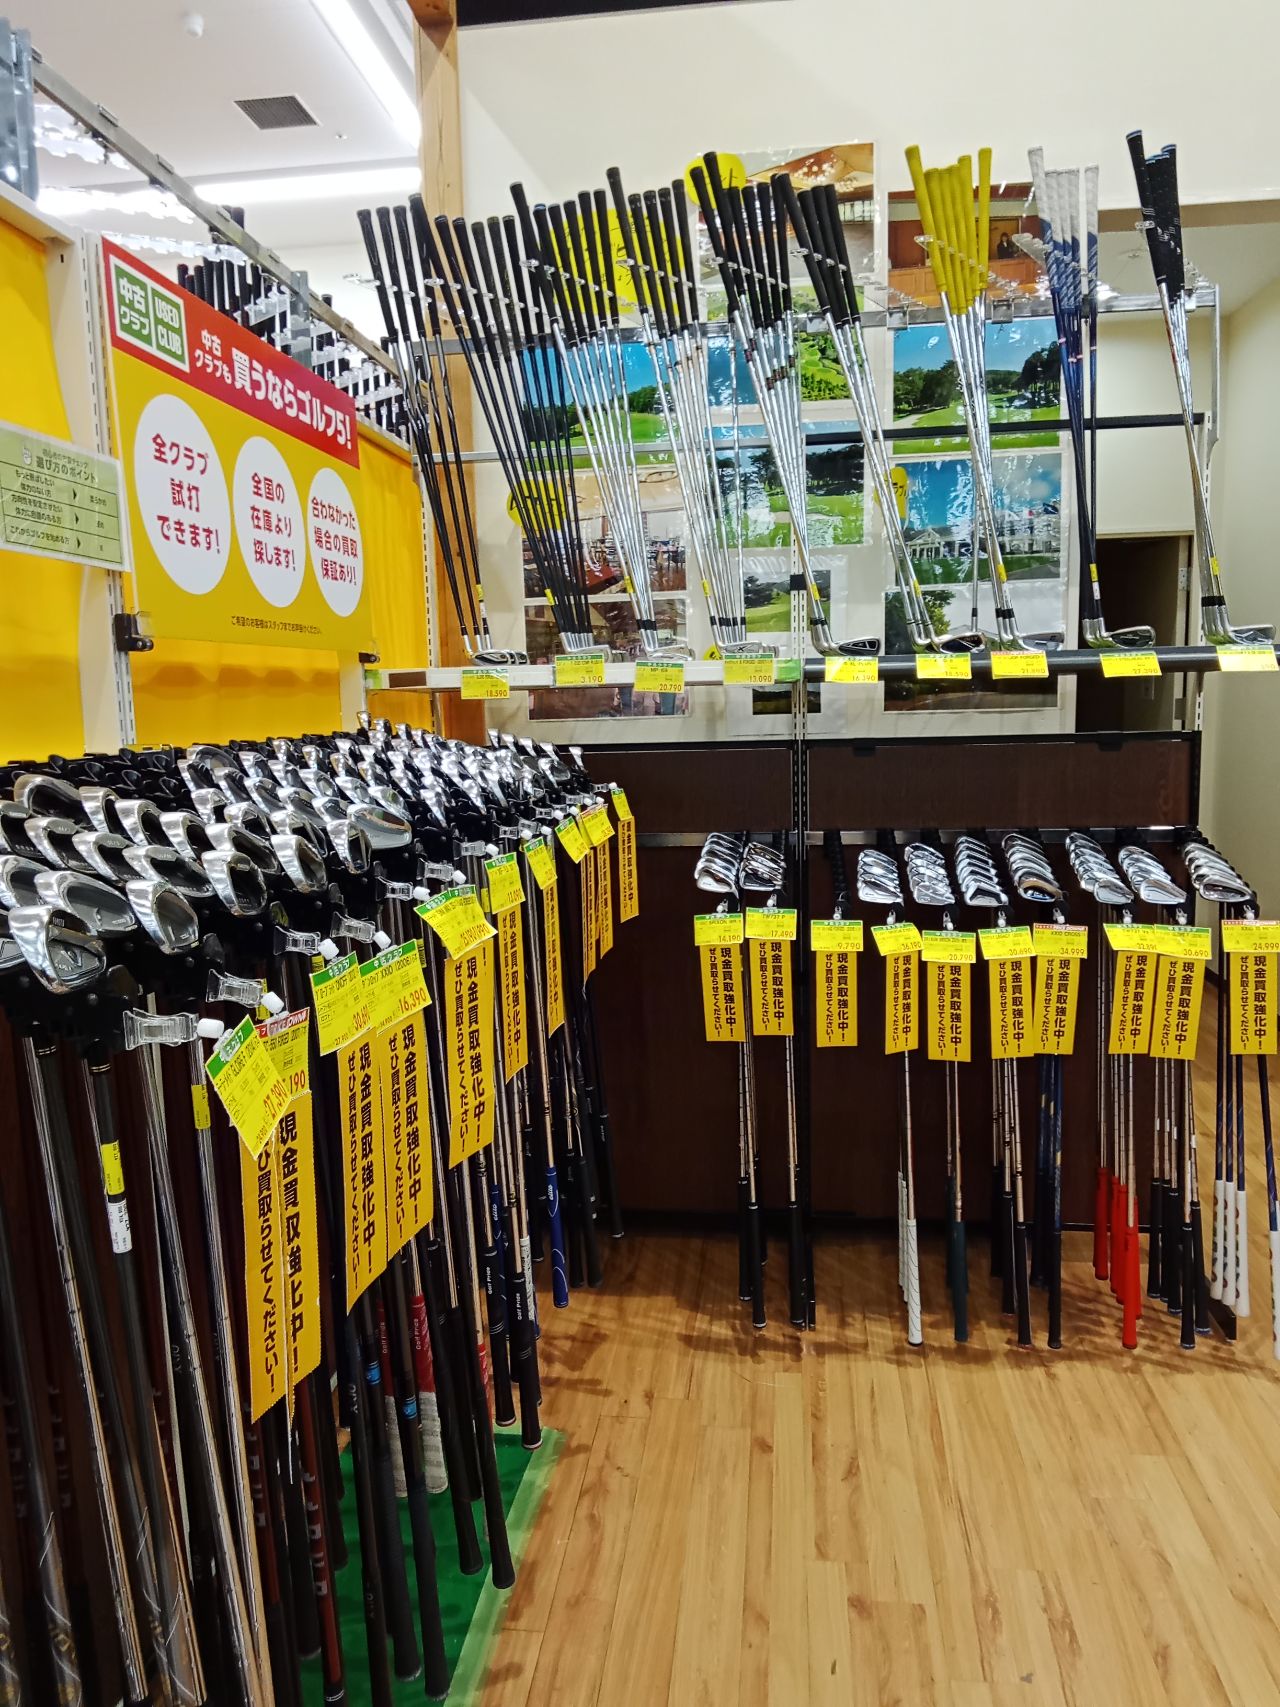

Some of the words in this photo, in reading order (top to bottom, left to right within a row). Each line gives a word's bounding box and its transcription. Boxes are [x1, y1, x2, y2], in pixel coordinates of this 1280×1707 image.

[120, 277, 146, 313] 中古
[120, 310, 150, 336] クラブ
[154, 297, 179, 329] USED
[157, 325, 182, 355] CLUB
[201, 329, 222, 357] 中古
[195, 349, 232, 385] クラブも
[152, 433, 208, 475] 全クラブ
[170, 478, 200, 512] 試打
[252, 472, 285, 504] 全国の
[250, 505, 291, 538] 在庫より
[311, 497, 355, 530] 合わなかった
[157, 515, 220, 554] できます!
[314, 527, 358, 559] 場合の買取
[399, 987, 427, 1014] 16,390
[263, 1080, 289, 1120] 27,390
[402, 1024, 421, 1225] 現金買取強化中!
[360, 1042, 375, 1275] 現金買取強化中!
[257, 1141, 278, 1393] ひ買取らせてください!
